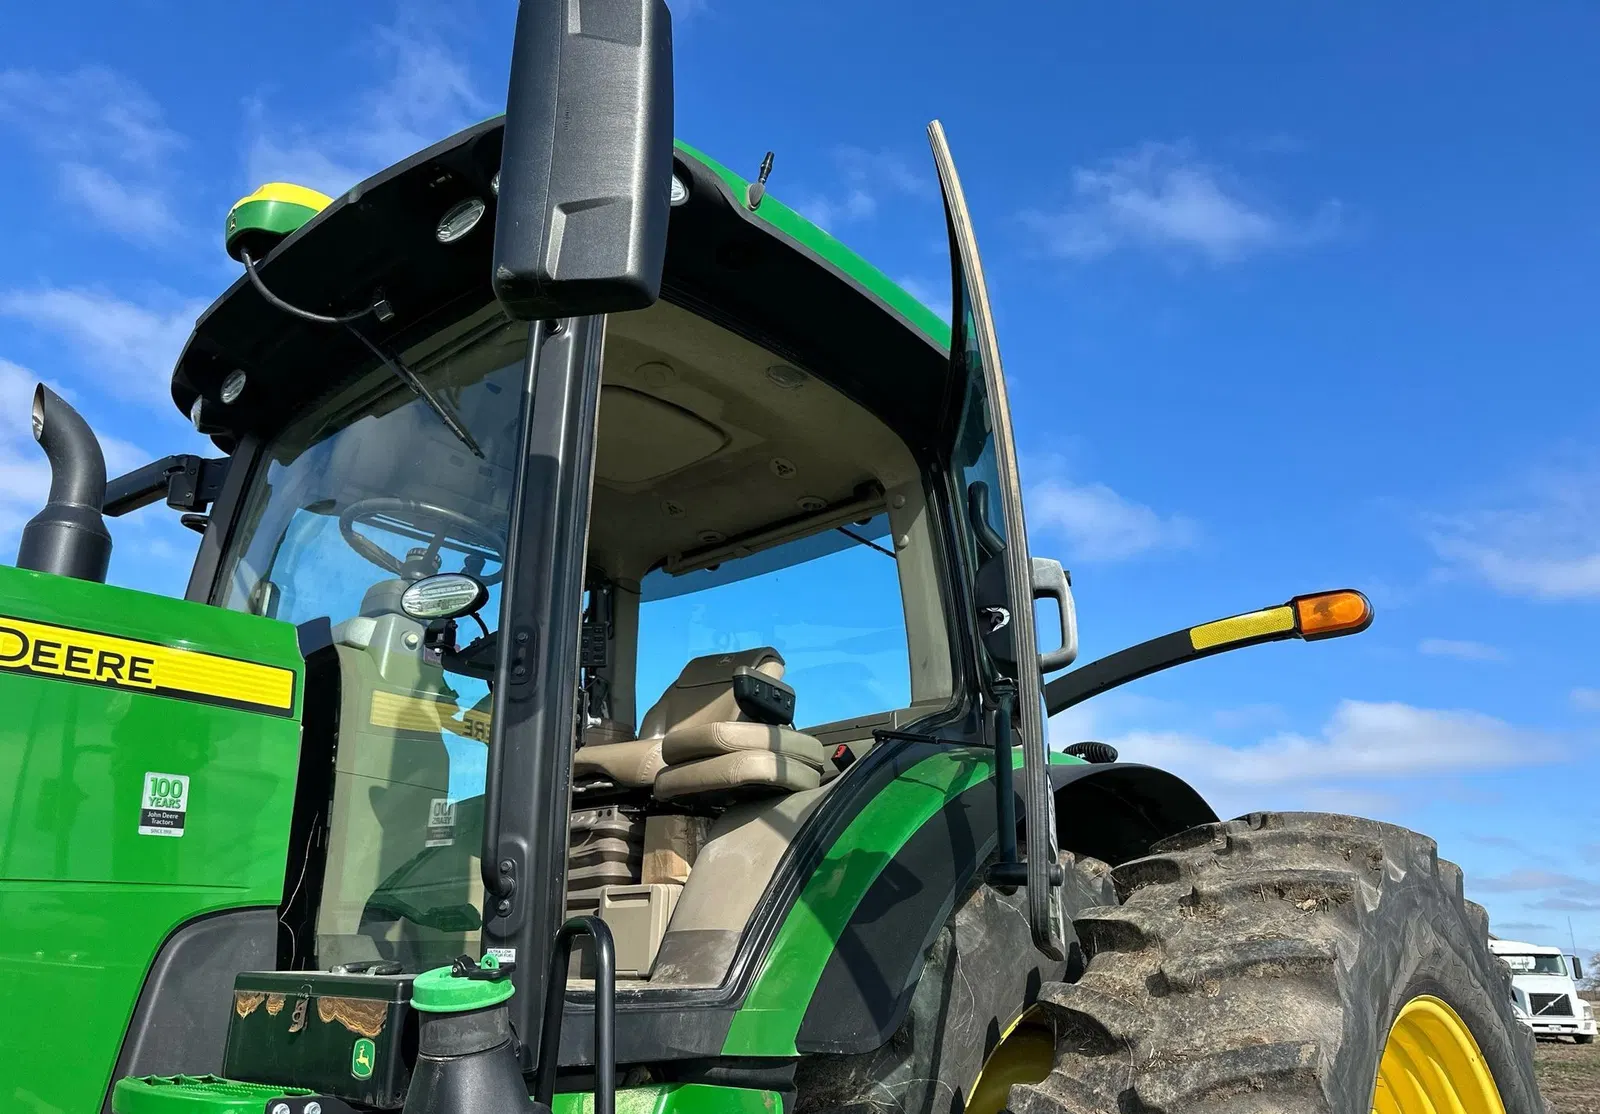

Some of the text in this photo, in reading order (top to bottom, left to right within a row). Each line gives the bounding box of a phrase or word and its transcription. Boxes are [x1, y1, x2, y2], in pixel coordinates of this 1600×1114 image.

[0, 626, 154, 684] DEERE
[151, 777, 183, 798] 100
[149, 797, 181, 809] YEARS
[151, 818, 174, 826] Tractors
